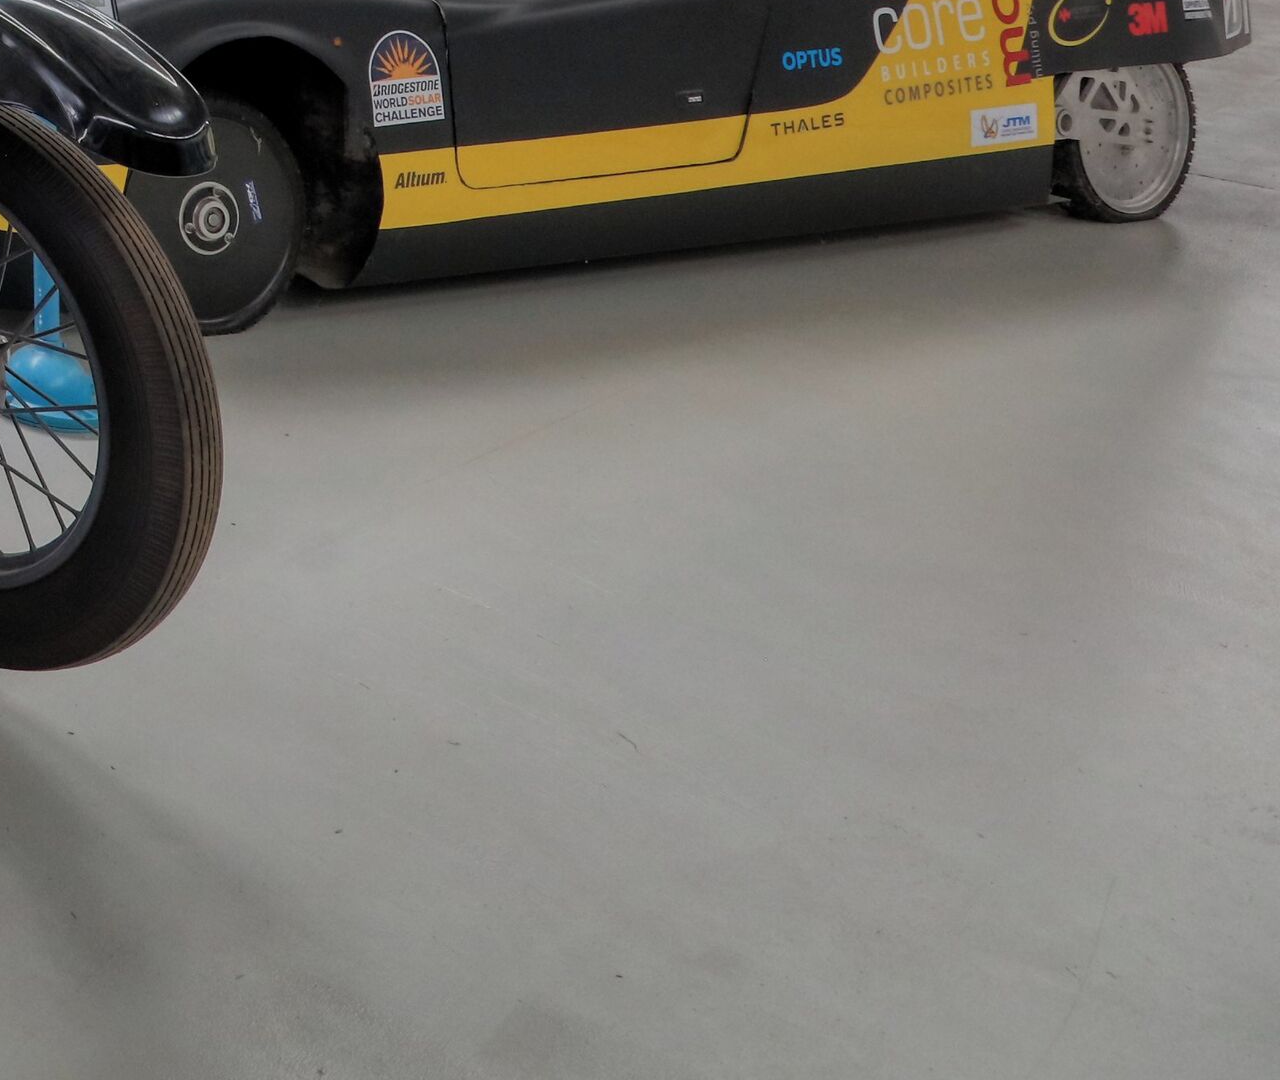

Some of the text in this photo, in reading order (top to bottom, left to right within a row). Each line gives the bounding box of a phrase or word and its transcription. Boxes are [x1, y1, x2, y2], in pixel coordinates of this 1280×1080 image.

[1128, 1, 1168, 36] 3M
[782, 47, 843, 70] OPTUS
[880, 50, 991, 83] BUILDERS
[373, 79, 439, 97] BRIDGESTONE
[884, 73, 993, 105] COMPOSITES
[373, 93, 441, 110] WORLD SOLAR
[375, 105, 443, 123] CHALLENGE
[770, 112, 844, 136] THALES
[1003, 115, 1030, 128] JTM
